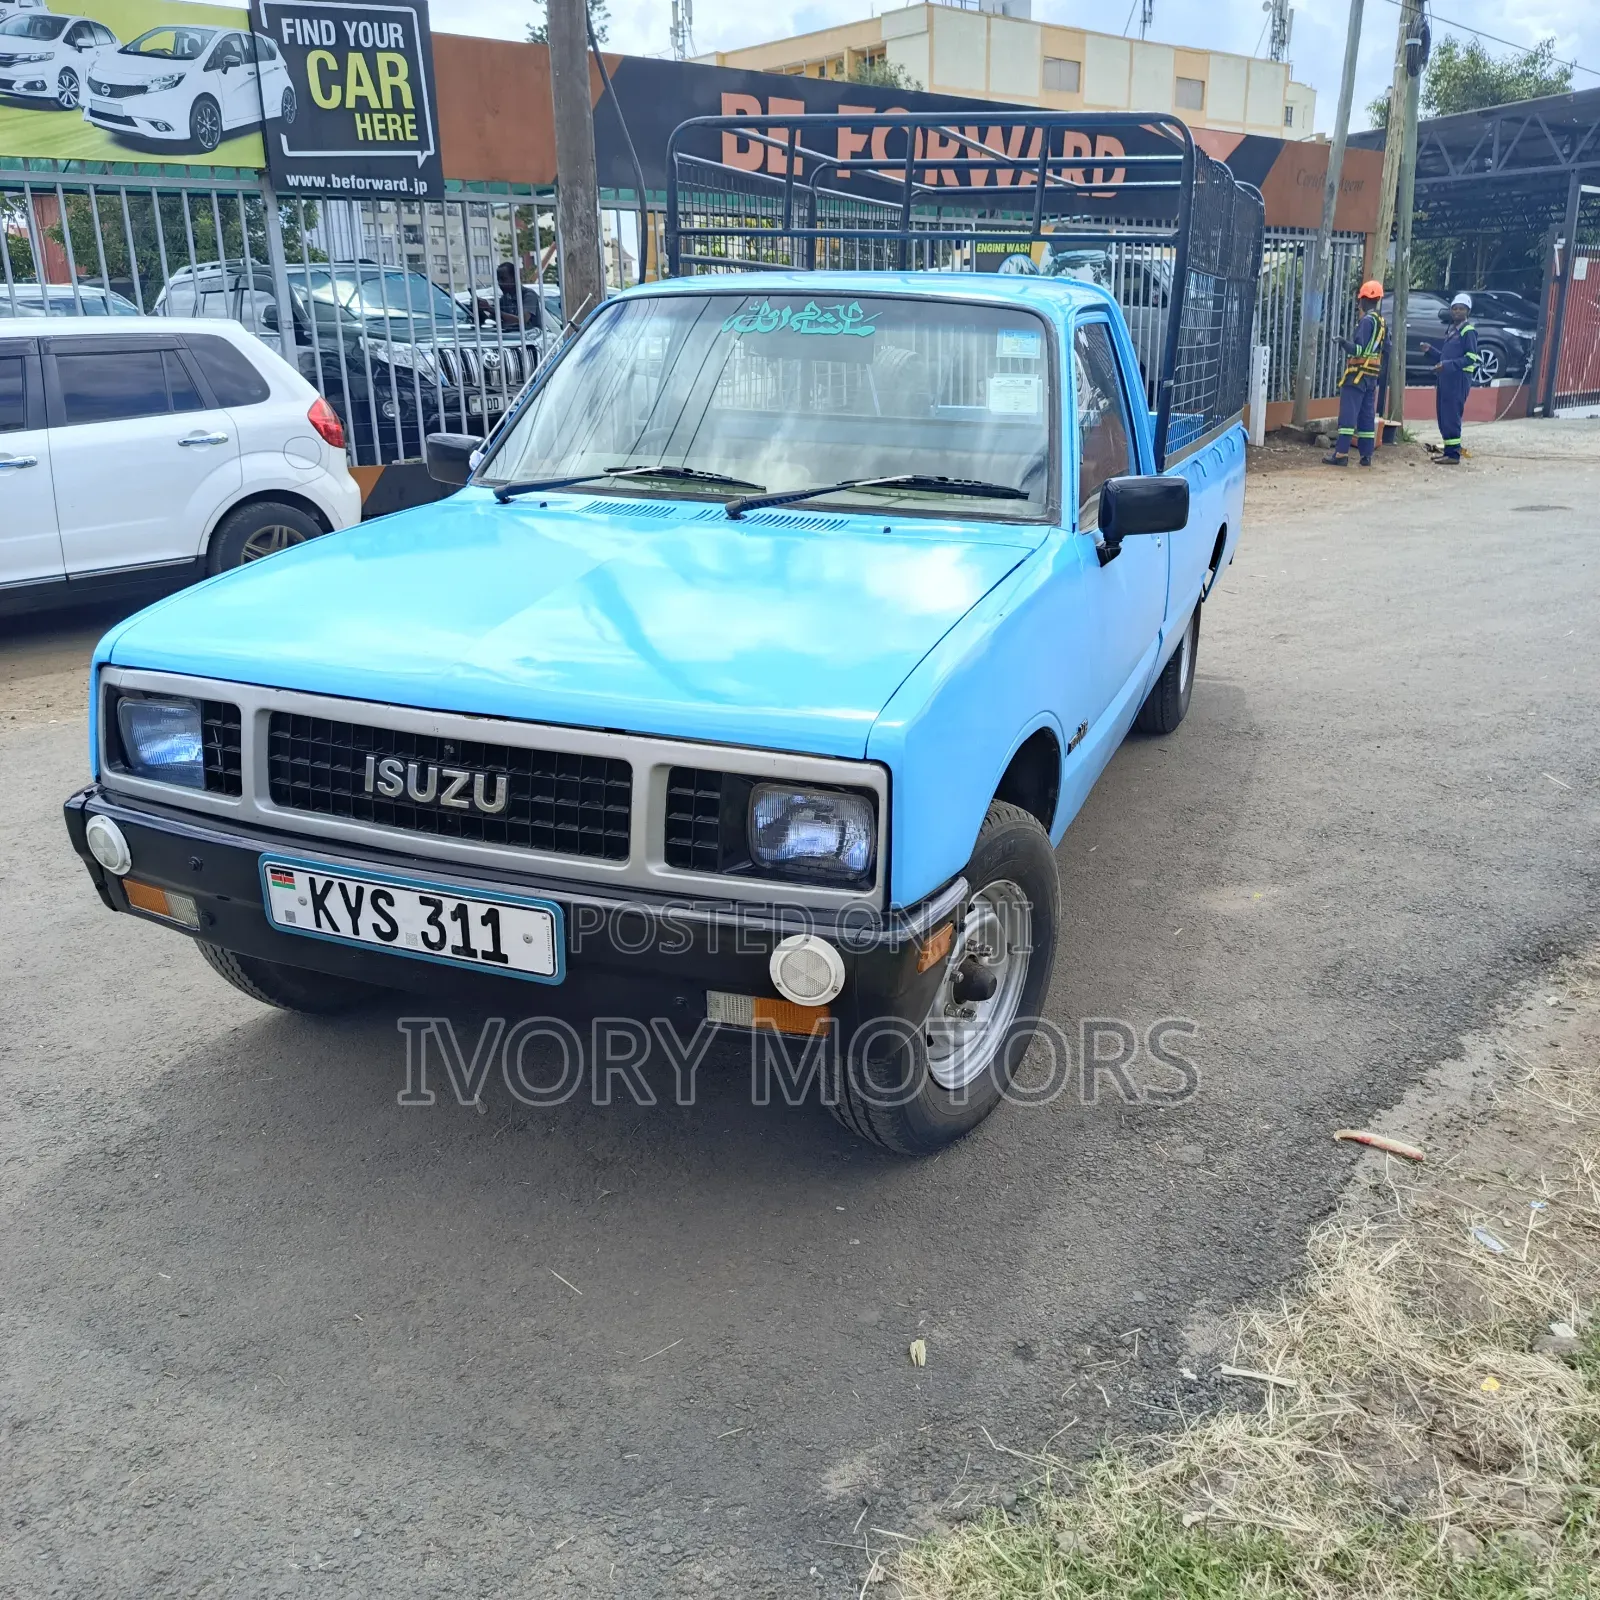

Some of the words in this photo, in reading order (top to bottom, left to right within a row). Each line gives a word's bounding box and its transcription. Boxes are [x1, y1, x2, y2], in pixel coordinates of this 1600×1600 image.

[281, 18, 336, 46] FIND
[343, 20, 405, 49] YOUR
[306, 50, 415, 110] CAR
[354, 112, 419, 141] HERE
[721, 92, 805, 176] BE
[837, 104, 1127, 198] FORWARD
[286, 173, 428, 196] www.beforward.jp
[976, 242, 1006, 254] ENGINE
[1006, 243, 1031, 254] WASH
[364, 754, 508, 814] ISUZU
[308, 876, 400, 942] KYS
[418, 895, 509, 965] 311
